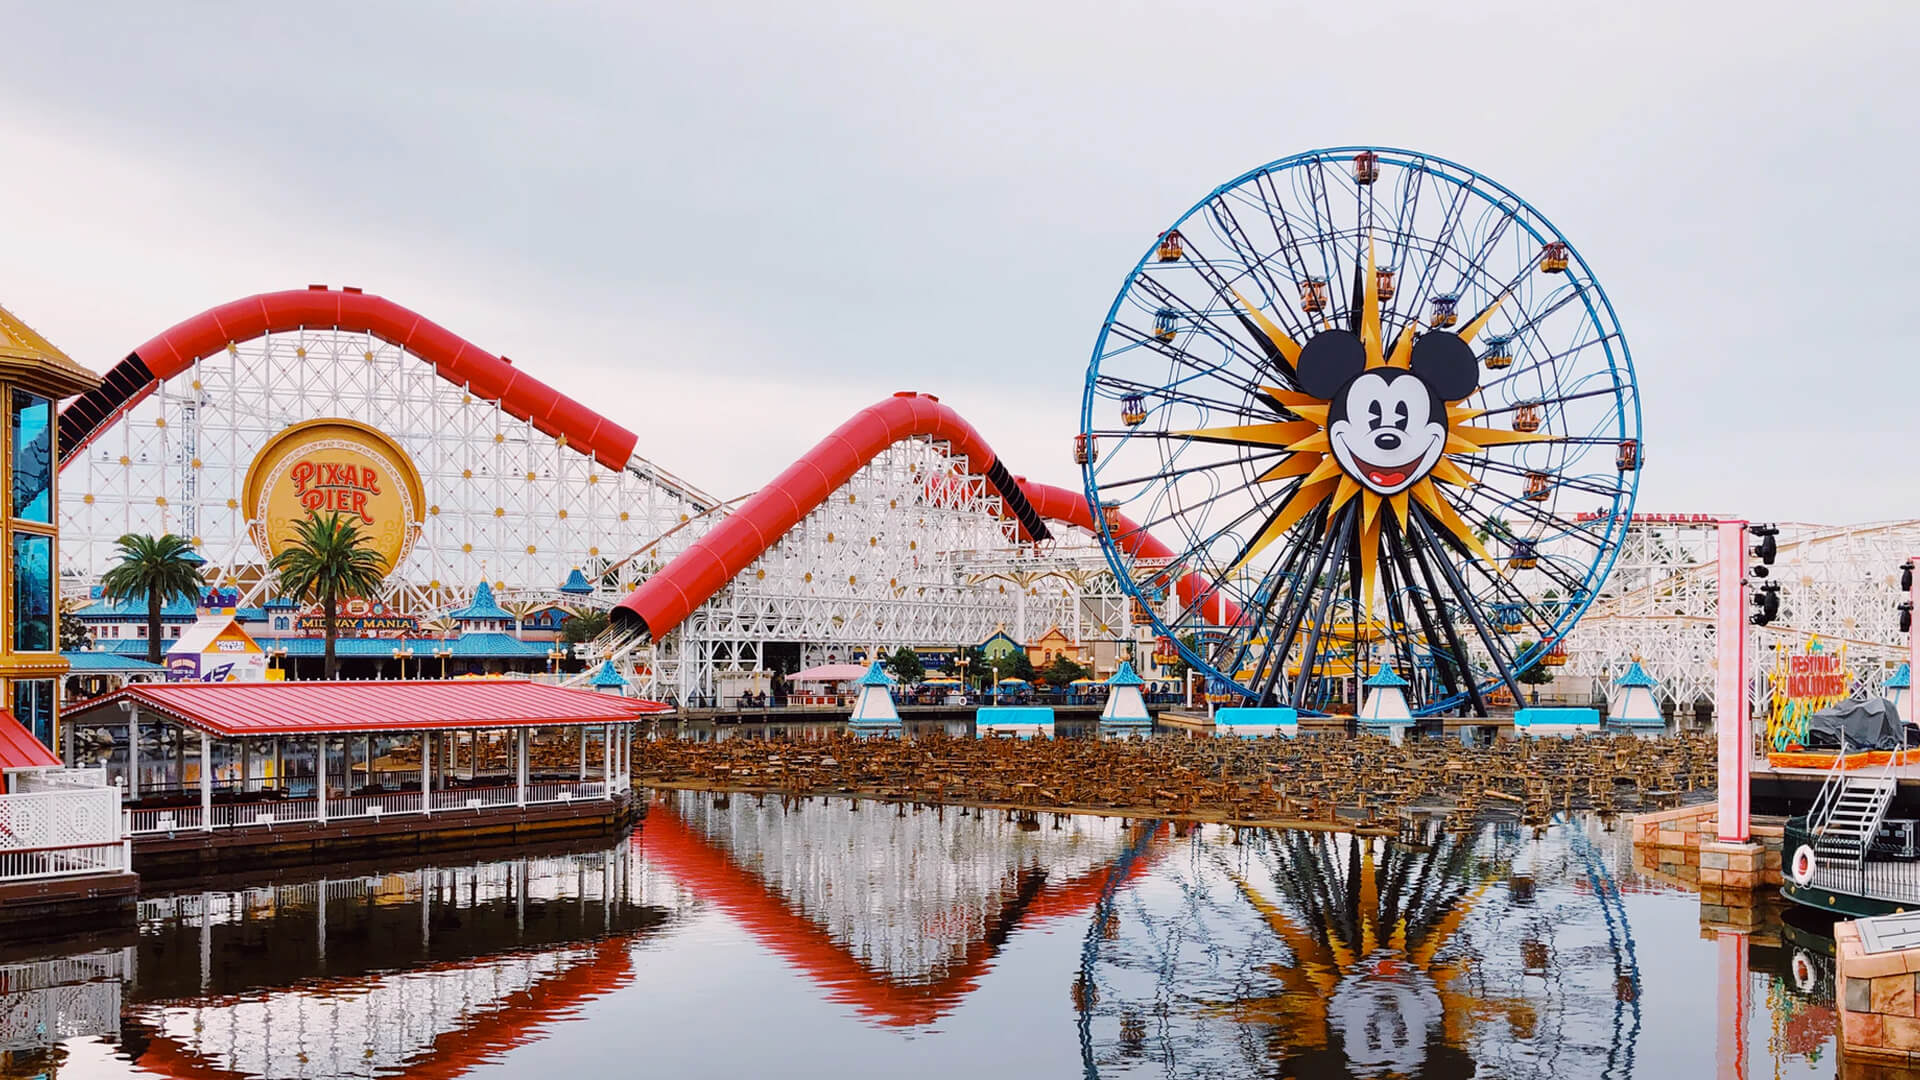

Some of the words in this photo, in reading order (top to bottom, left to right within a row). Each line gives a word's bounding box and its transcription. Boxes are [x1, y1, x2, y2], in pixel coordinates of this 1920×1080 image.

[291, 461, 381, 497] PIXAR
[302, 488, 375, 525] PIER
[1791, 655, 1834, 673] FESTIVAL
[1788, 675, 1844, 698] HOLIDAYS
